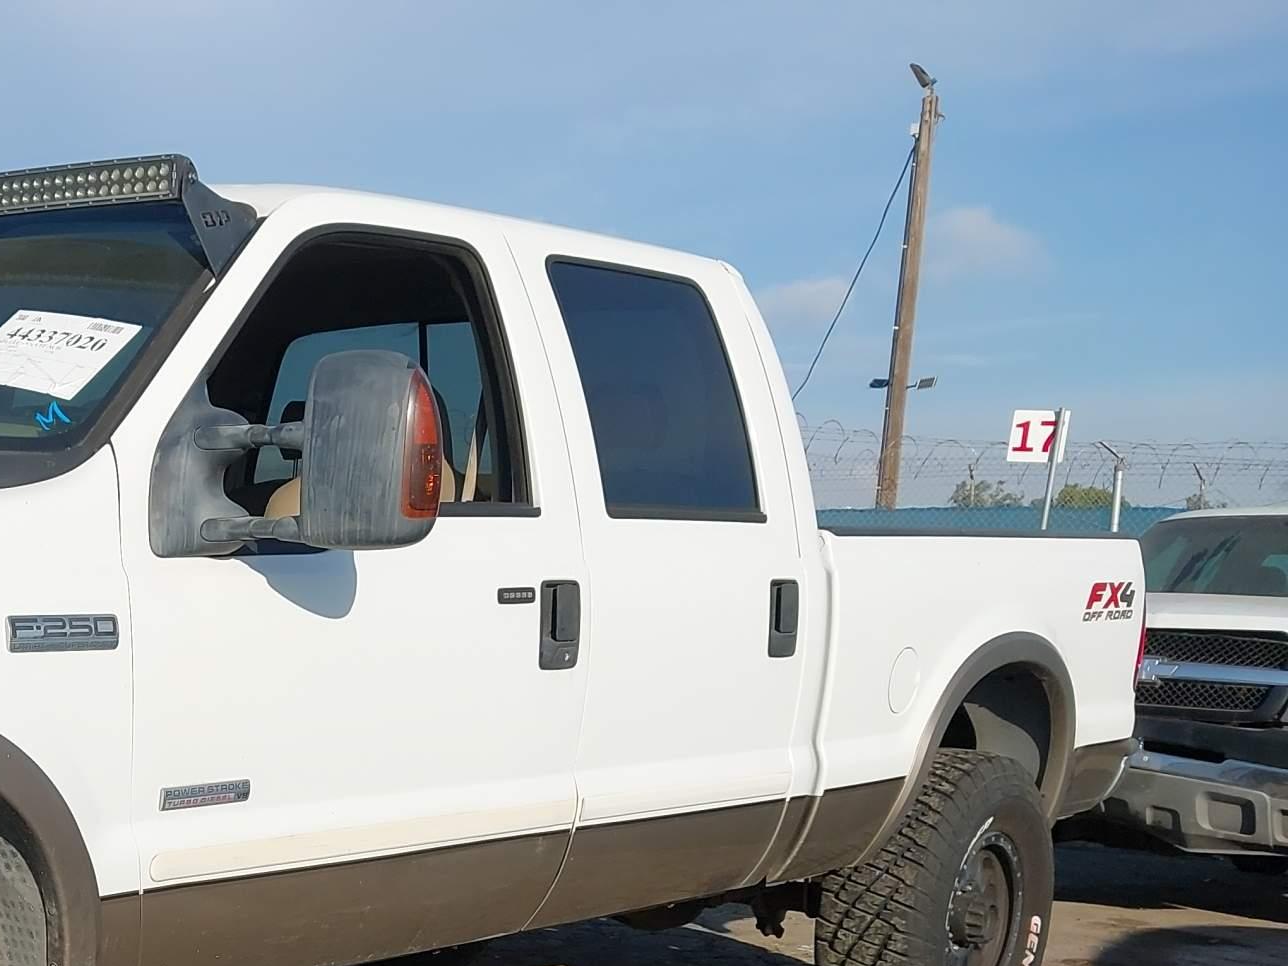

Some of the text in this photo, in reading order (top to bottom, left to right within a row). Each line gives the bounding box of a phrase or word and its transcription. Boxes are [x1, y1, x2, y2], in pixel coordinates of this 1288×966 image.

[7, 326, 108, 352] 44337020
[34, 400, 71, 431] M
[1011, 420, 1057, 453] 17
[1085, 581, 1136, 609] FX4
[1082, 609, 1134, 622] OFF ROAD
[165, 782, 249, 797] POWER STROKE
[167, 798, 200, 808] TURBO
[236, 792, 249, 800] V8
